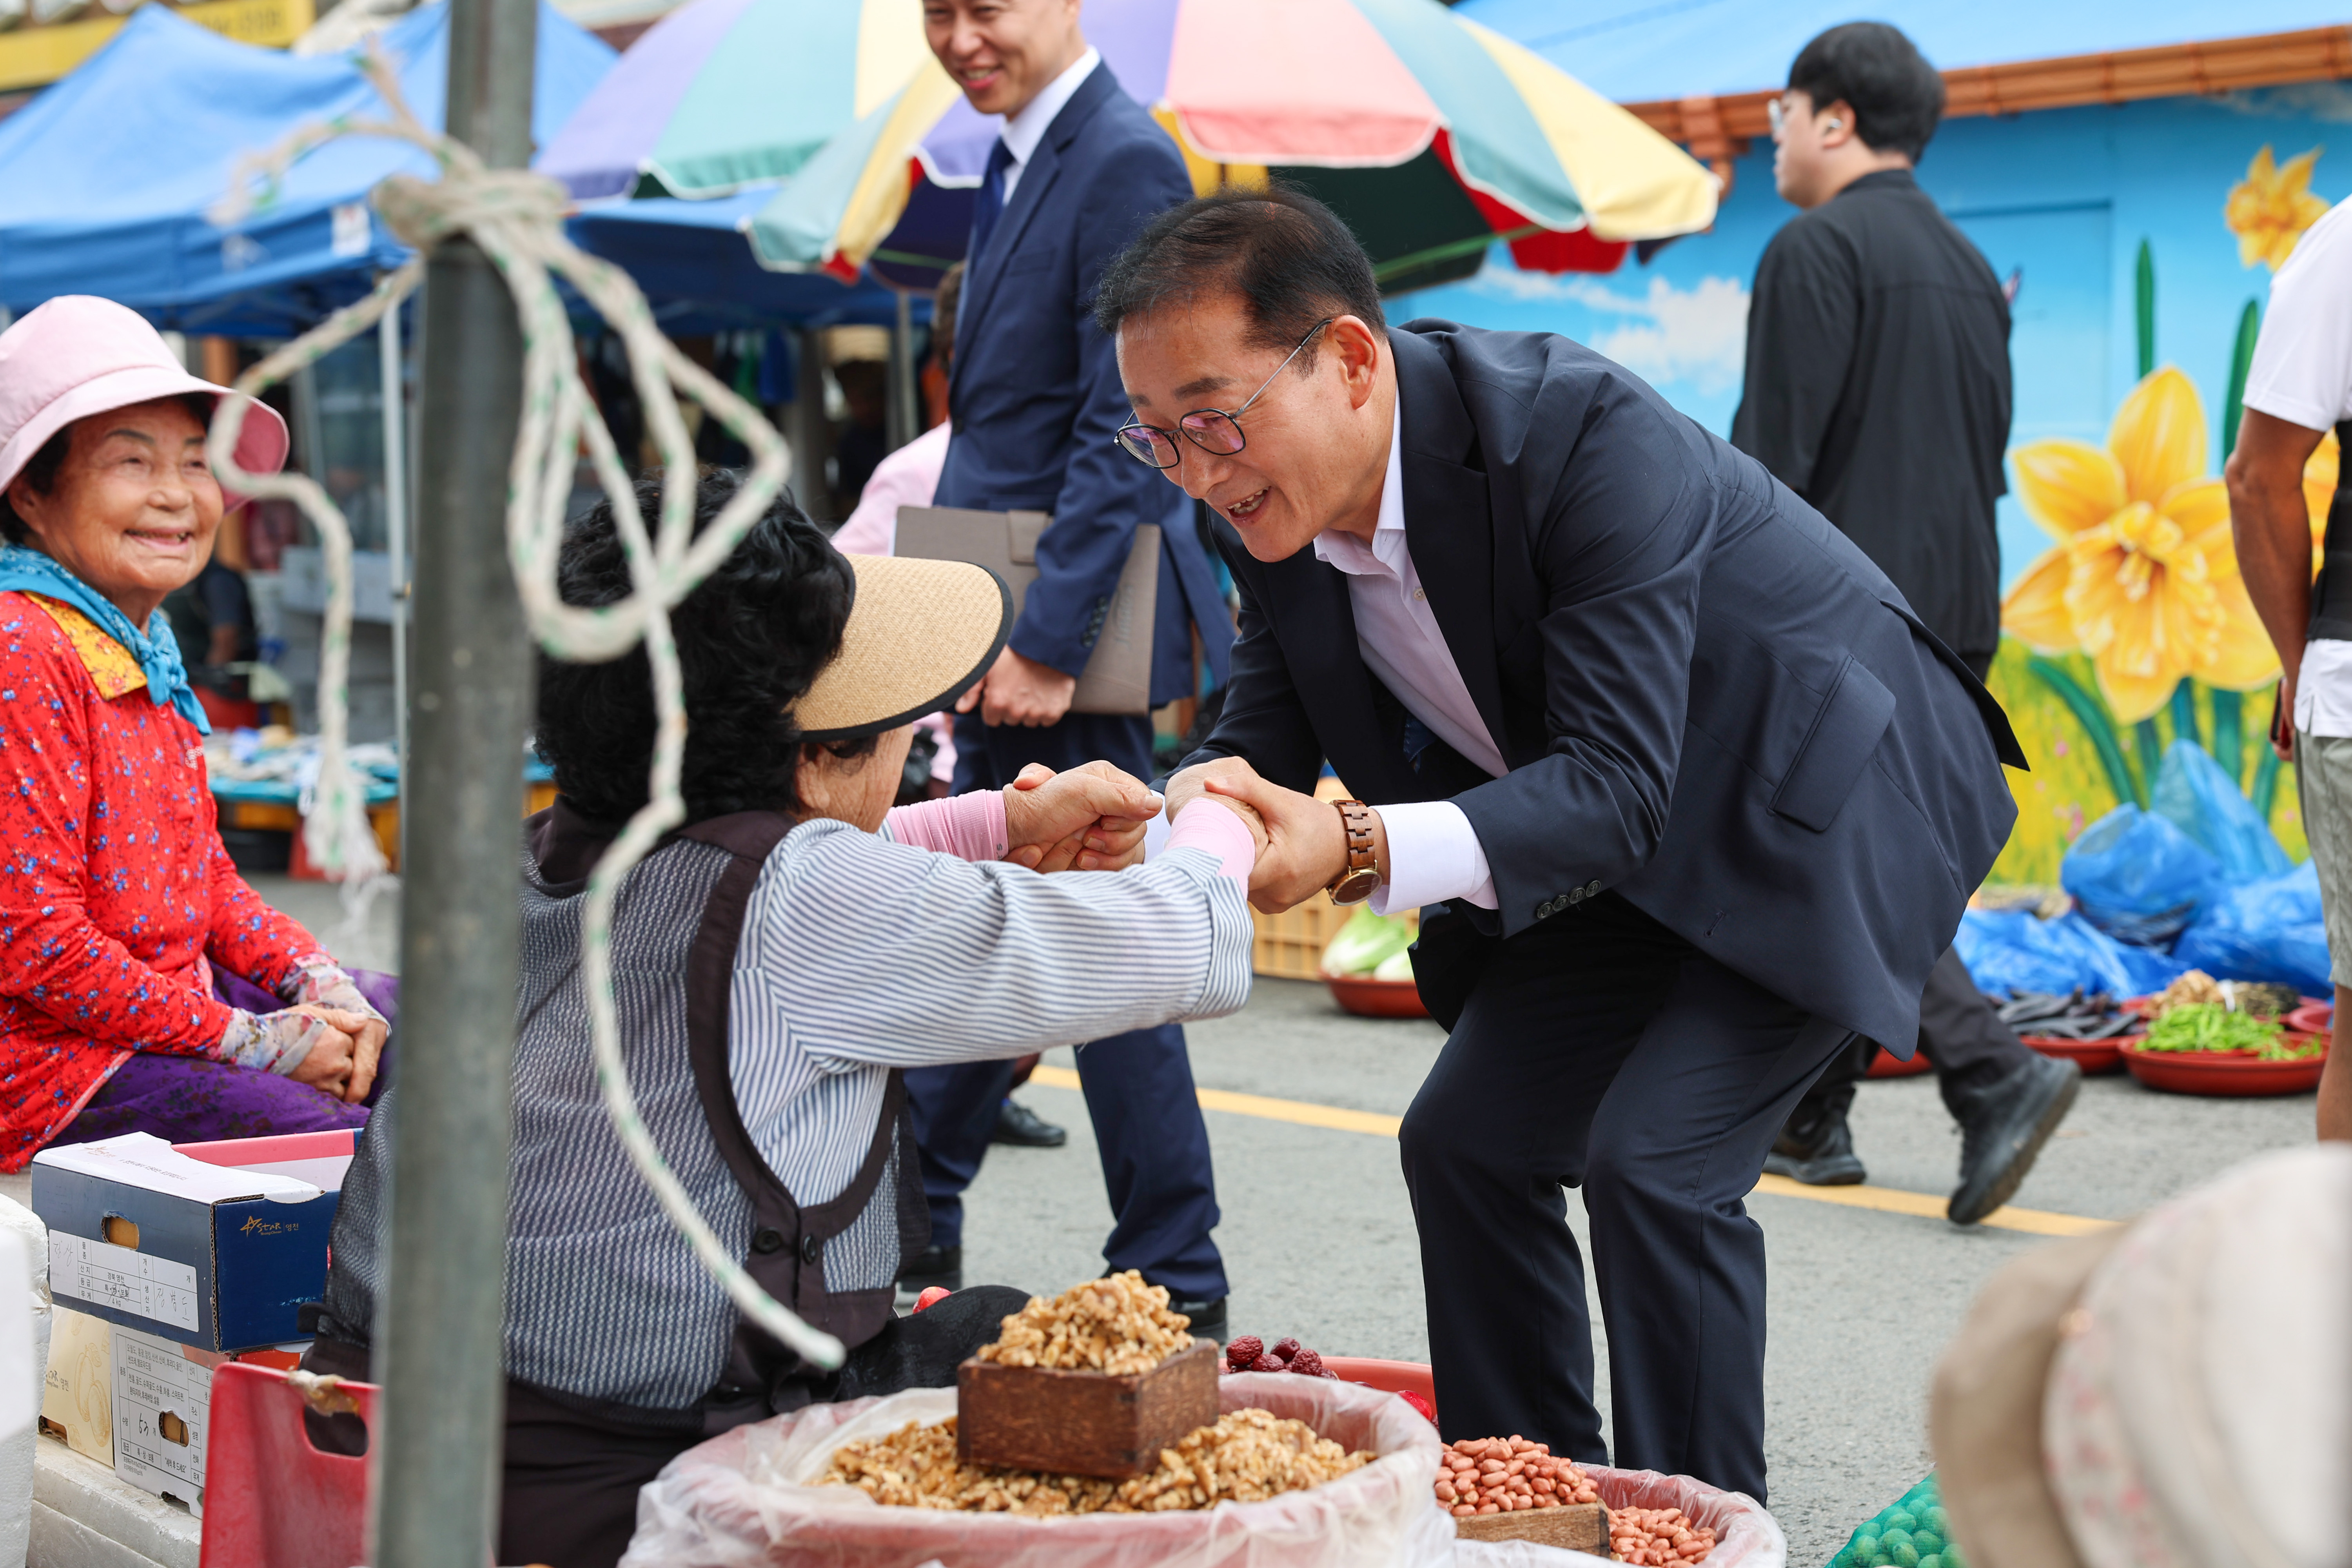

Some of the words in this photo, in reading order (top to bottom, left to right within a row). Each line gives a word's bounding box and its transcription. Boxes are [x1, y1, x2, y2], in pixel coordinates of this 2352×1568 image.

[285, 1223, 299, 1231] 영천
[80, 1278, 90, 1287] 등급
[107, 1272, 116, 1281] 경북
[116, 1274, 125, 1283] 영천
[81, 1290, 91, 1300] 무게
[60, 1378, 69, 1392] 영천
[191, 1406, 198, 1416] 주소
[122, 1416, 129, 1426] 수량
[192, 1430, 198, 1441] 성명
[123, 1442, 129, 1452] 등급
[192, 1454, 200, 1465] 전화
[172, 1461, 176, 1470] 후
[193, 1472, 200, 1483] 무게
